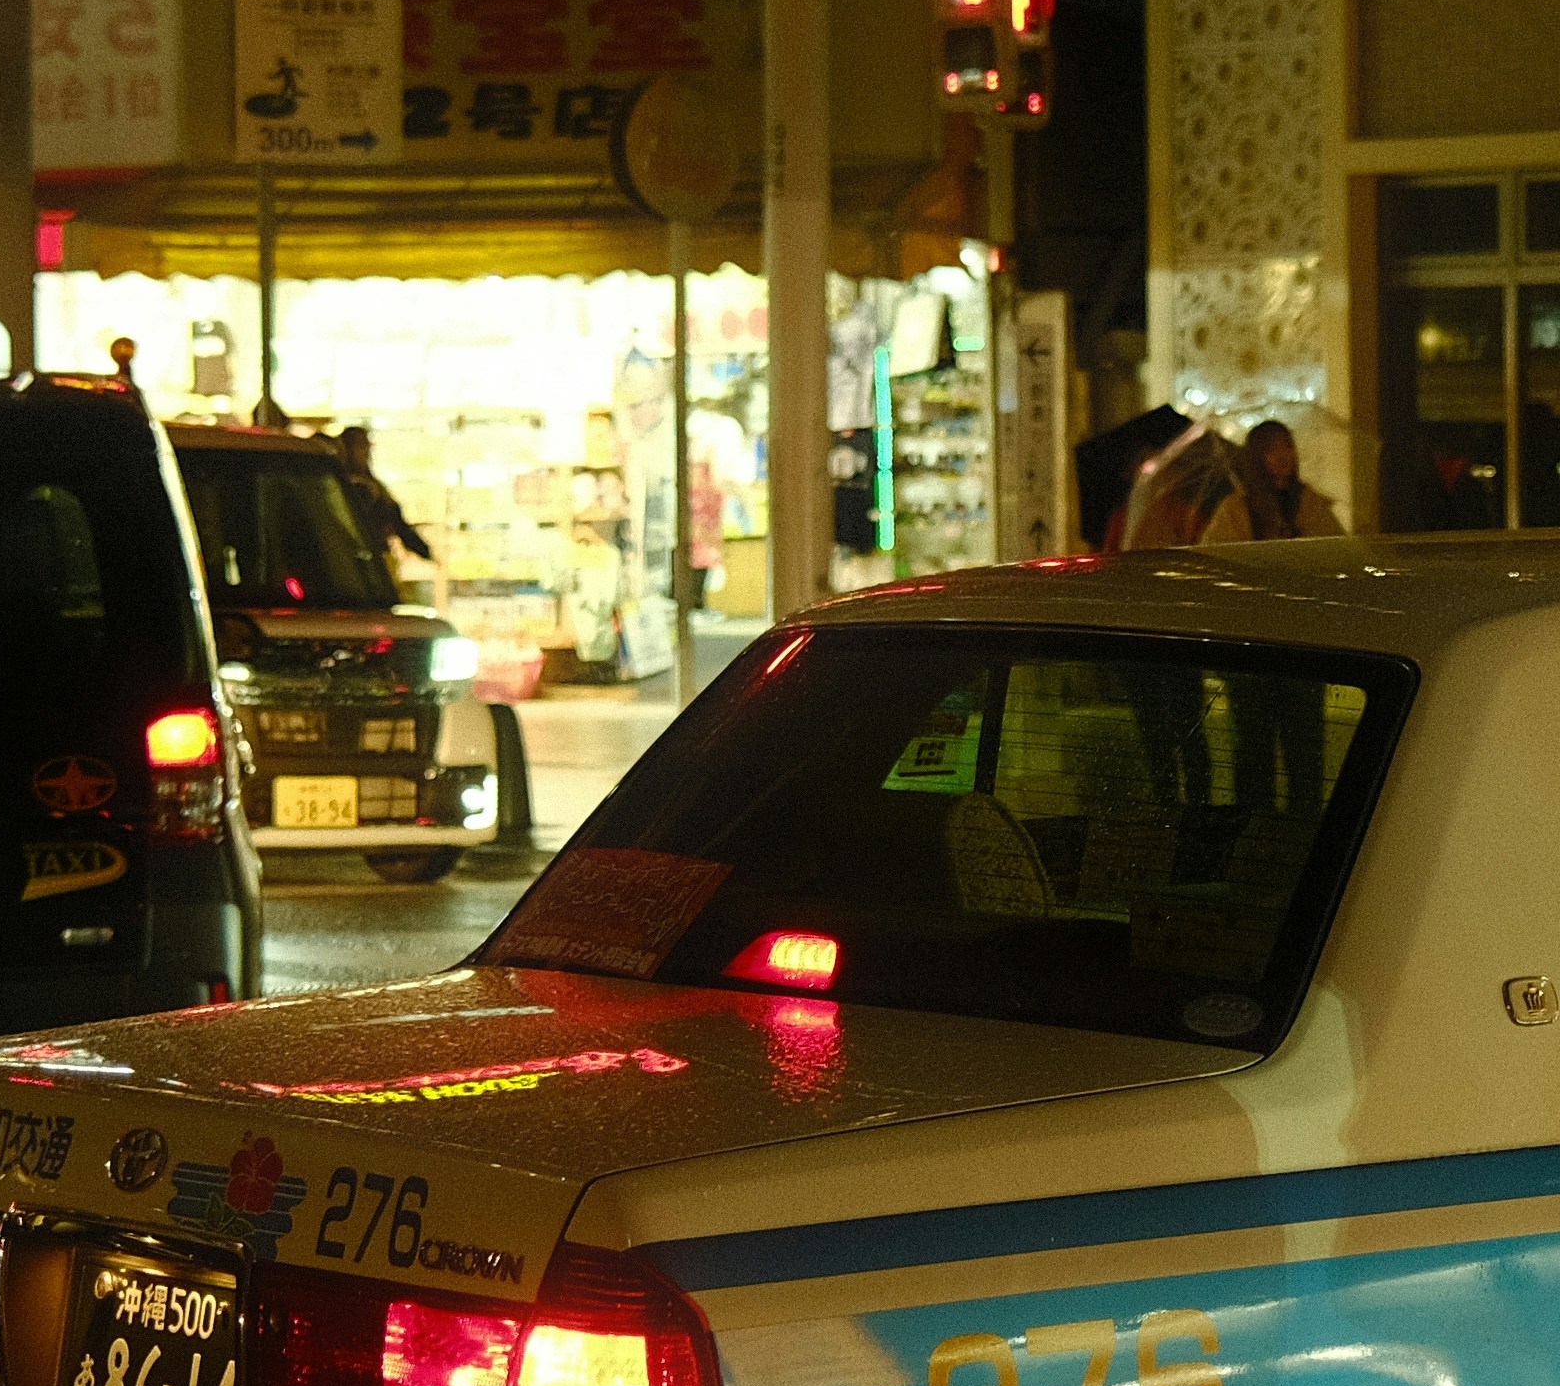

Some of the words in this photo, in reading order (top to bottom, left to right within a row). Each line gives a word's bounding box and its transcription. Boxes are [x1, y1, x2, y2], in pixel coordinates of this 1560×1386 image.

[23, 844, 102, 877] TAXI
[315, 1165, 430, 1269] 276
[418, 1238, 525, 1286] CROWN
